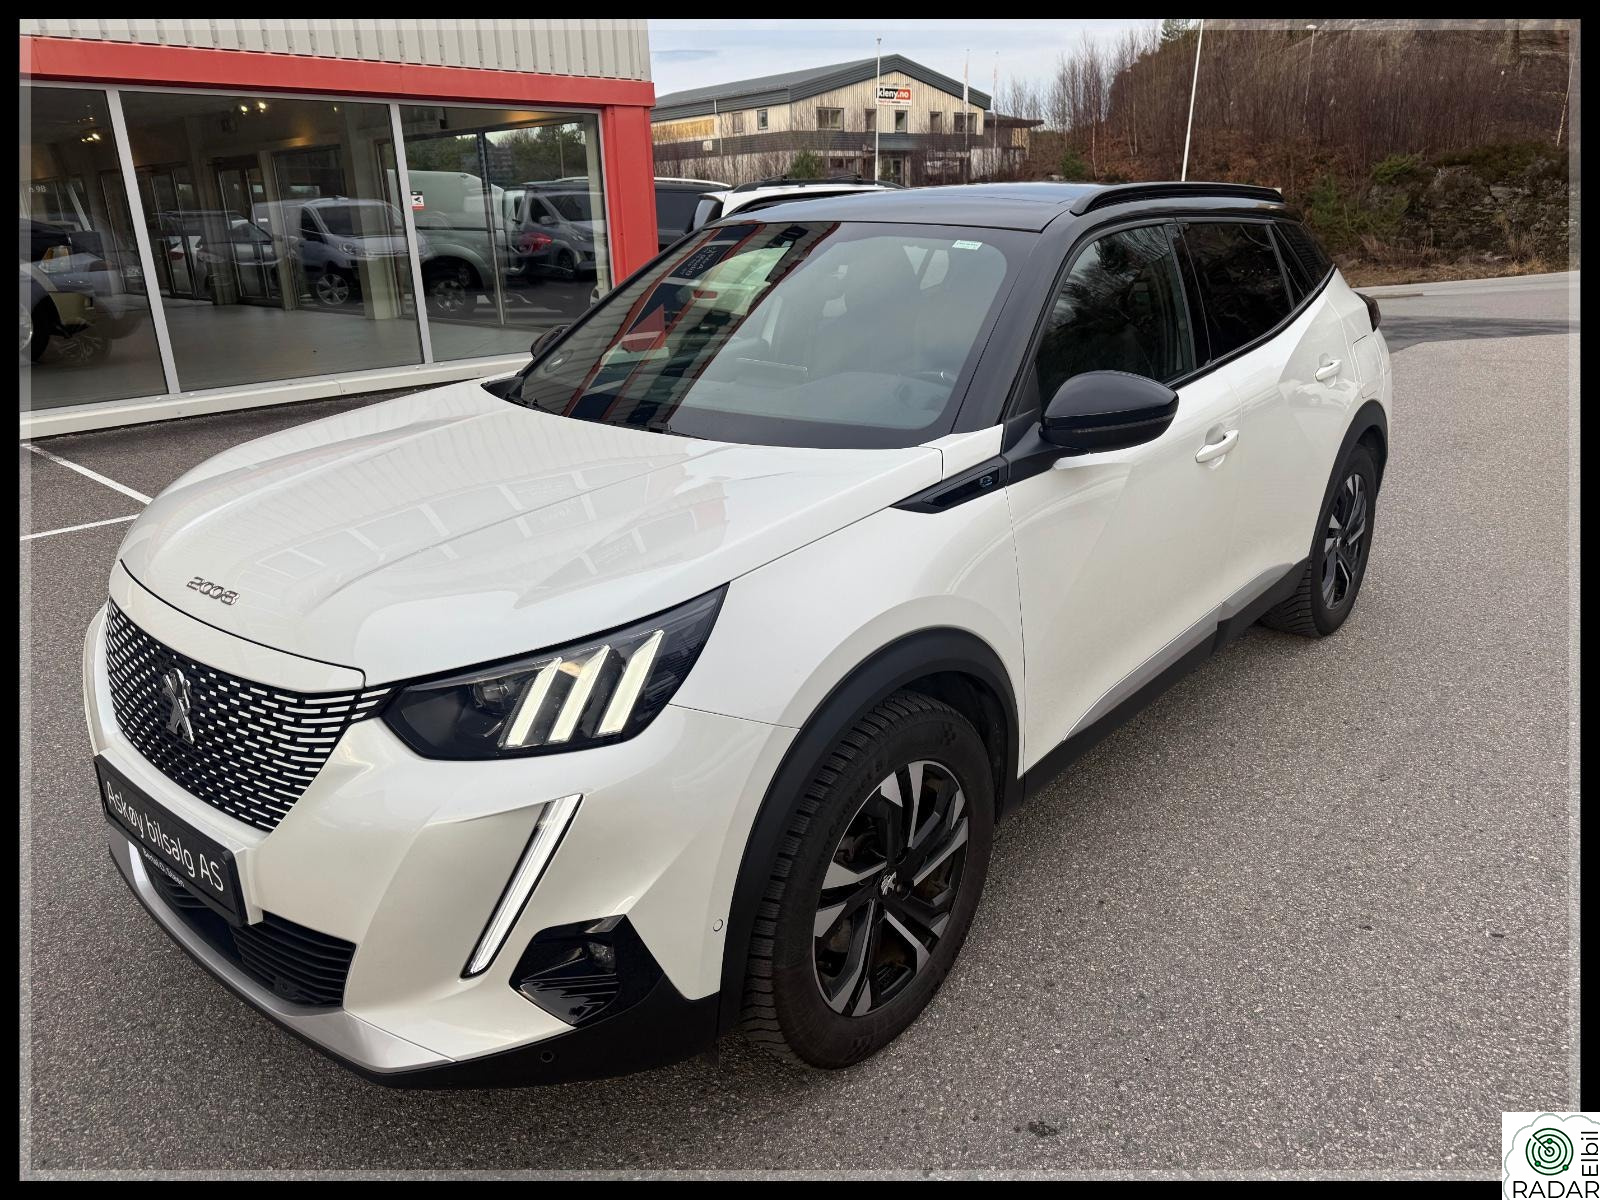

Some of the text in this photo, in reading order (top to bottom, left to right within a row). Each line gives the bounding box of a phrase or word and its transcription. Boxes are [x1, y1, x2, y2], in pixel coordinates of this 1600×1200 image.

[187, 576, 240, 606] 2008
[106, 780, 145, 839] Askøy
[145, 812, 196, 878] bilsalg
[199, 853, 225, 892] AS
